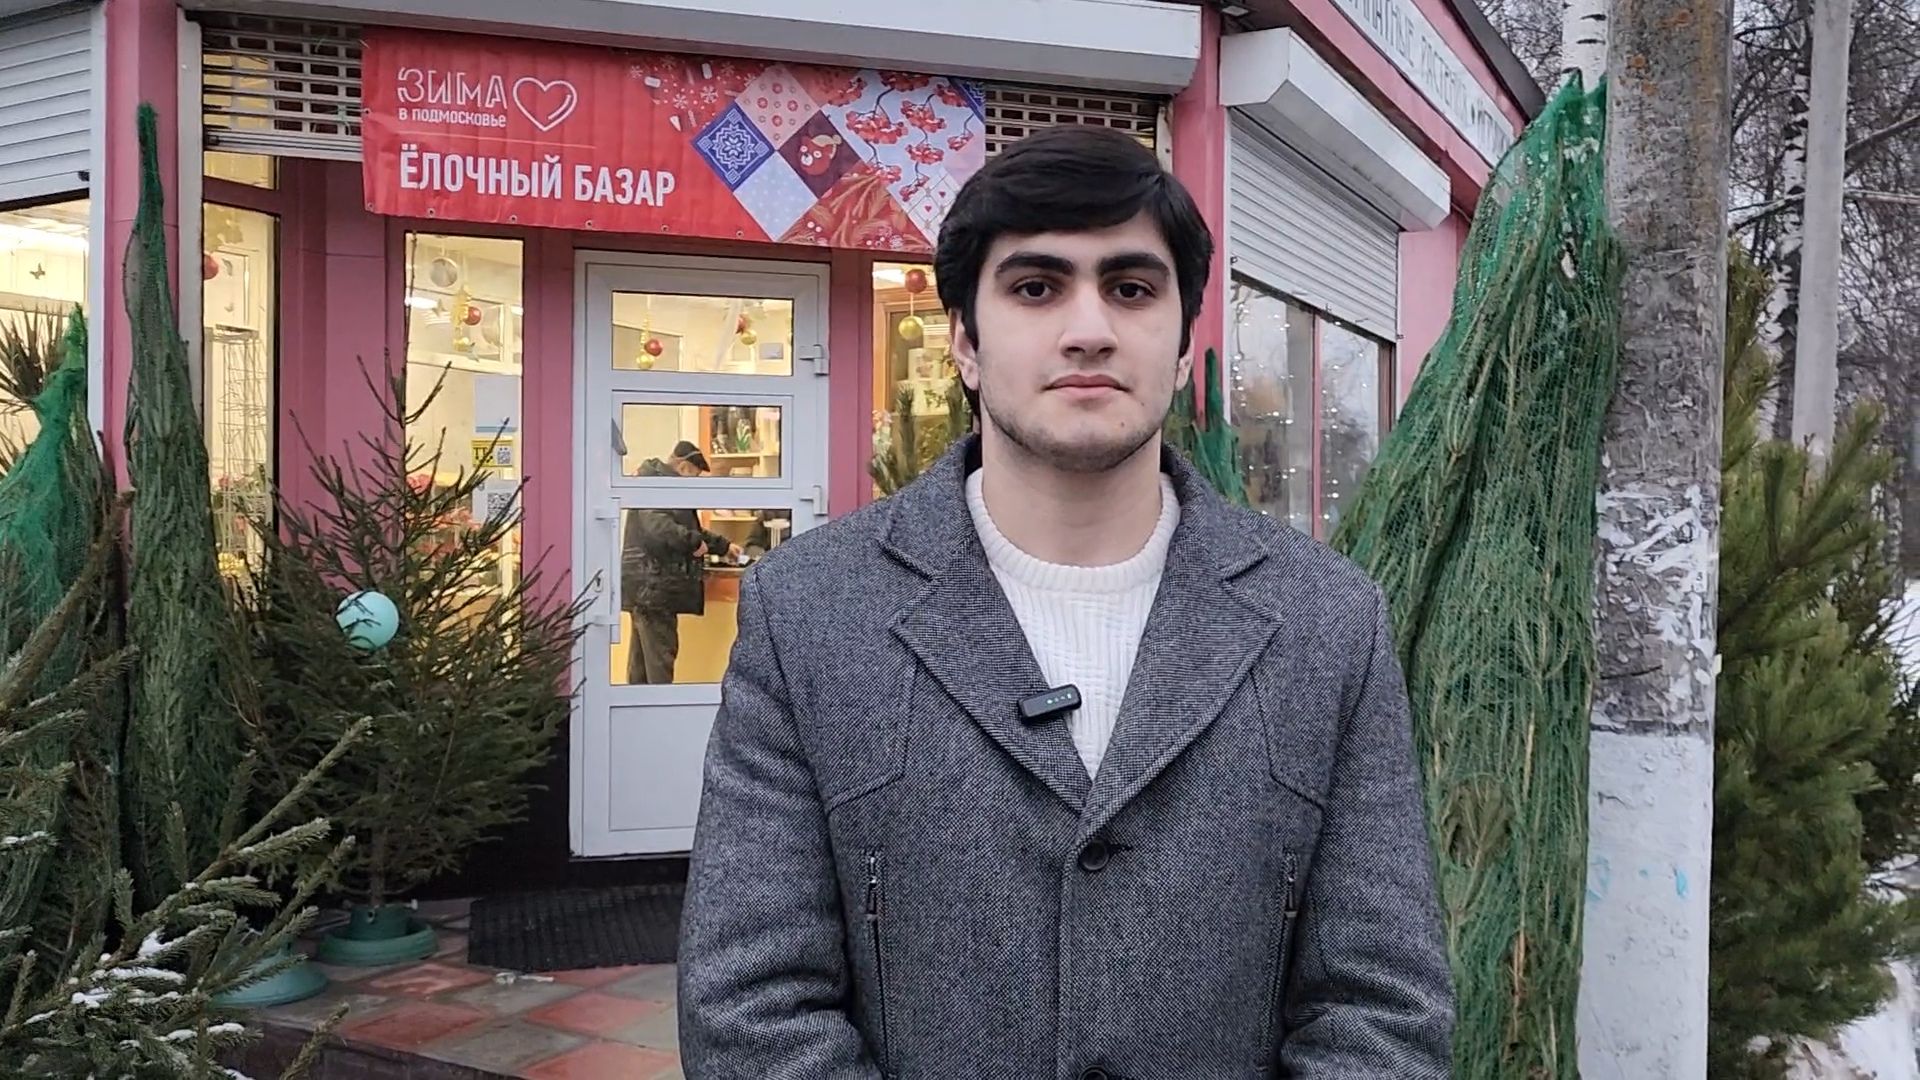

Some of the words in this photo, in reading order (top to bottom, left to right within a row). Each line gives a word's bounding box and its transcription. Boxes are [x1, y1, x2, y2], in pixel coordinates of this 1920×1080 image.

[397, 67, 508, 109] ЗИМА
[400, 144, 562, 199] ЁЛОЧНЫЙ
[574, 165, 676, 207] БАЗАР
